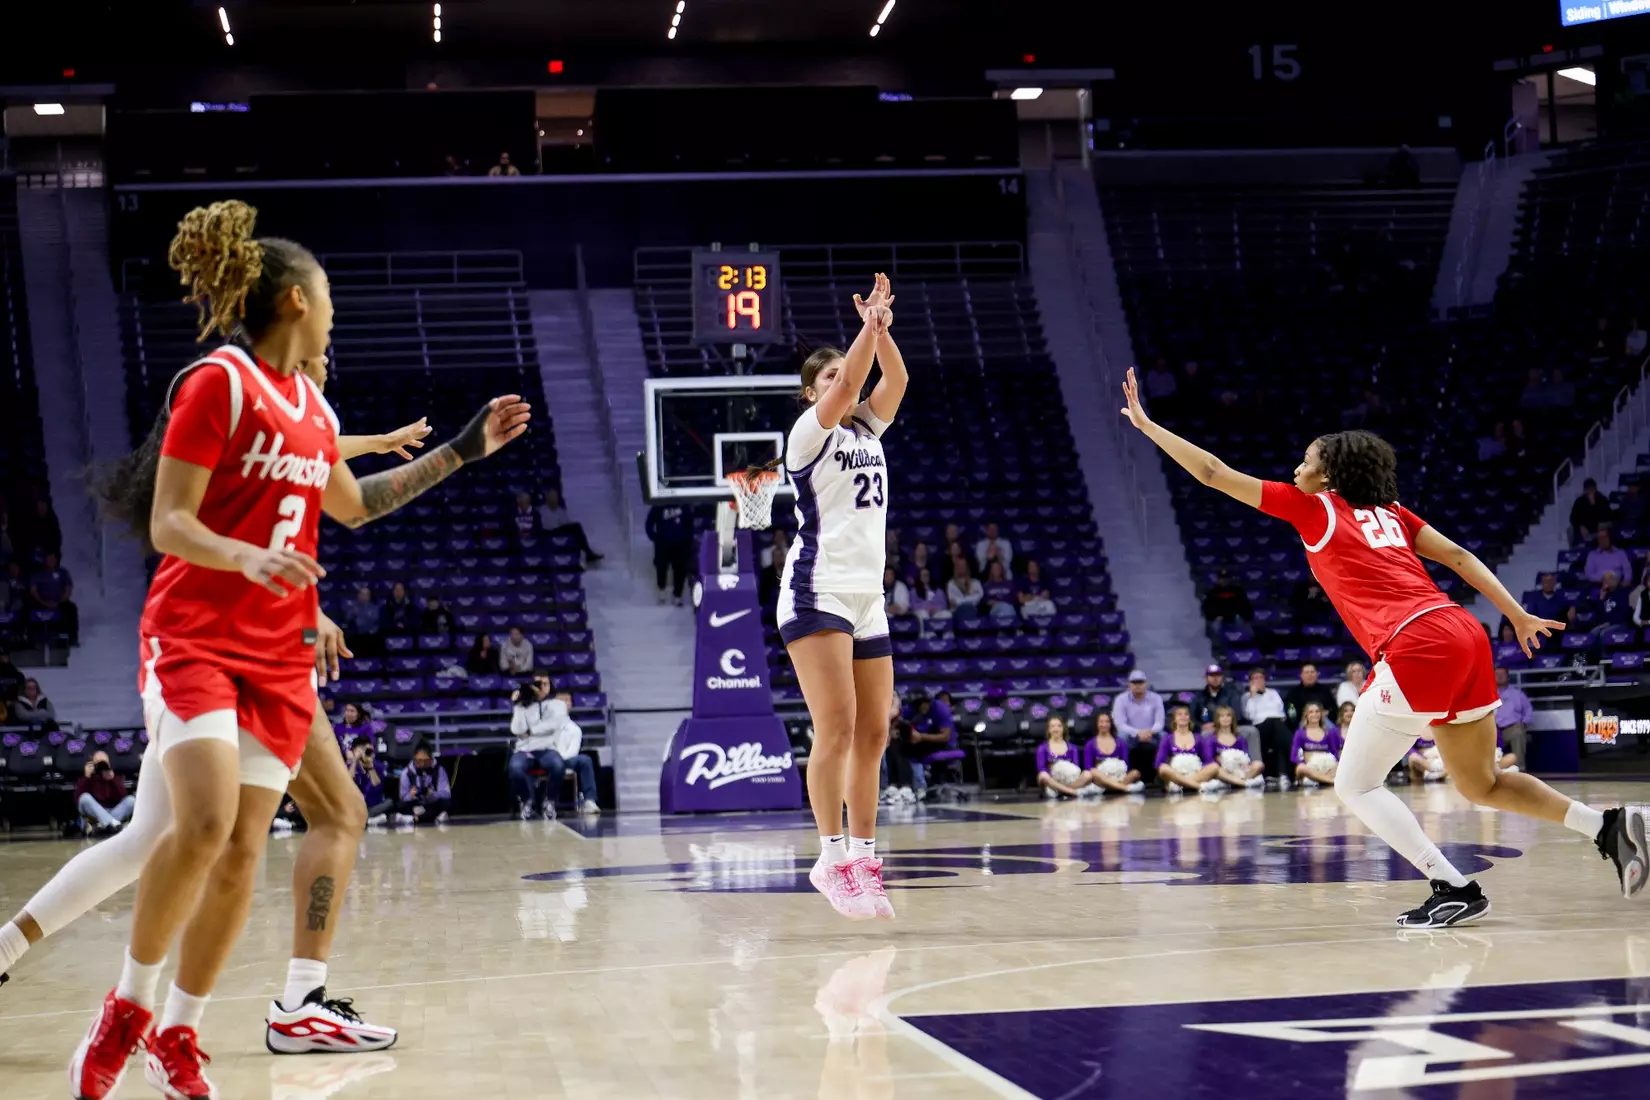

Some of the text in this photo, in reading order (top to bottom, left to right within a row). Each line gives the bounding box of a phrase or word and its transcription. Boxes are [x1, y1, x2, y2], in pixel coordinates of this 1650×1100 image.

[1248, 43, 1302, 82] 15
[118, 193, 140, 213] 13
[998, 177, 1020, 195] 14
[719, 265, 767, 290] 2:13
[728, 291, 761, 330] 19
[853, 472, 884, 510] 23
[268, 494, 307, 551] 2
[1353, 506, 1407, 549] 26
[1585, 709, 1619, 743] Briggs
[680, 742, 793, 786] Dillons
